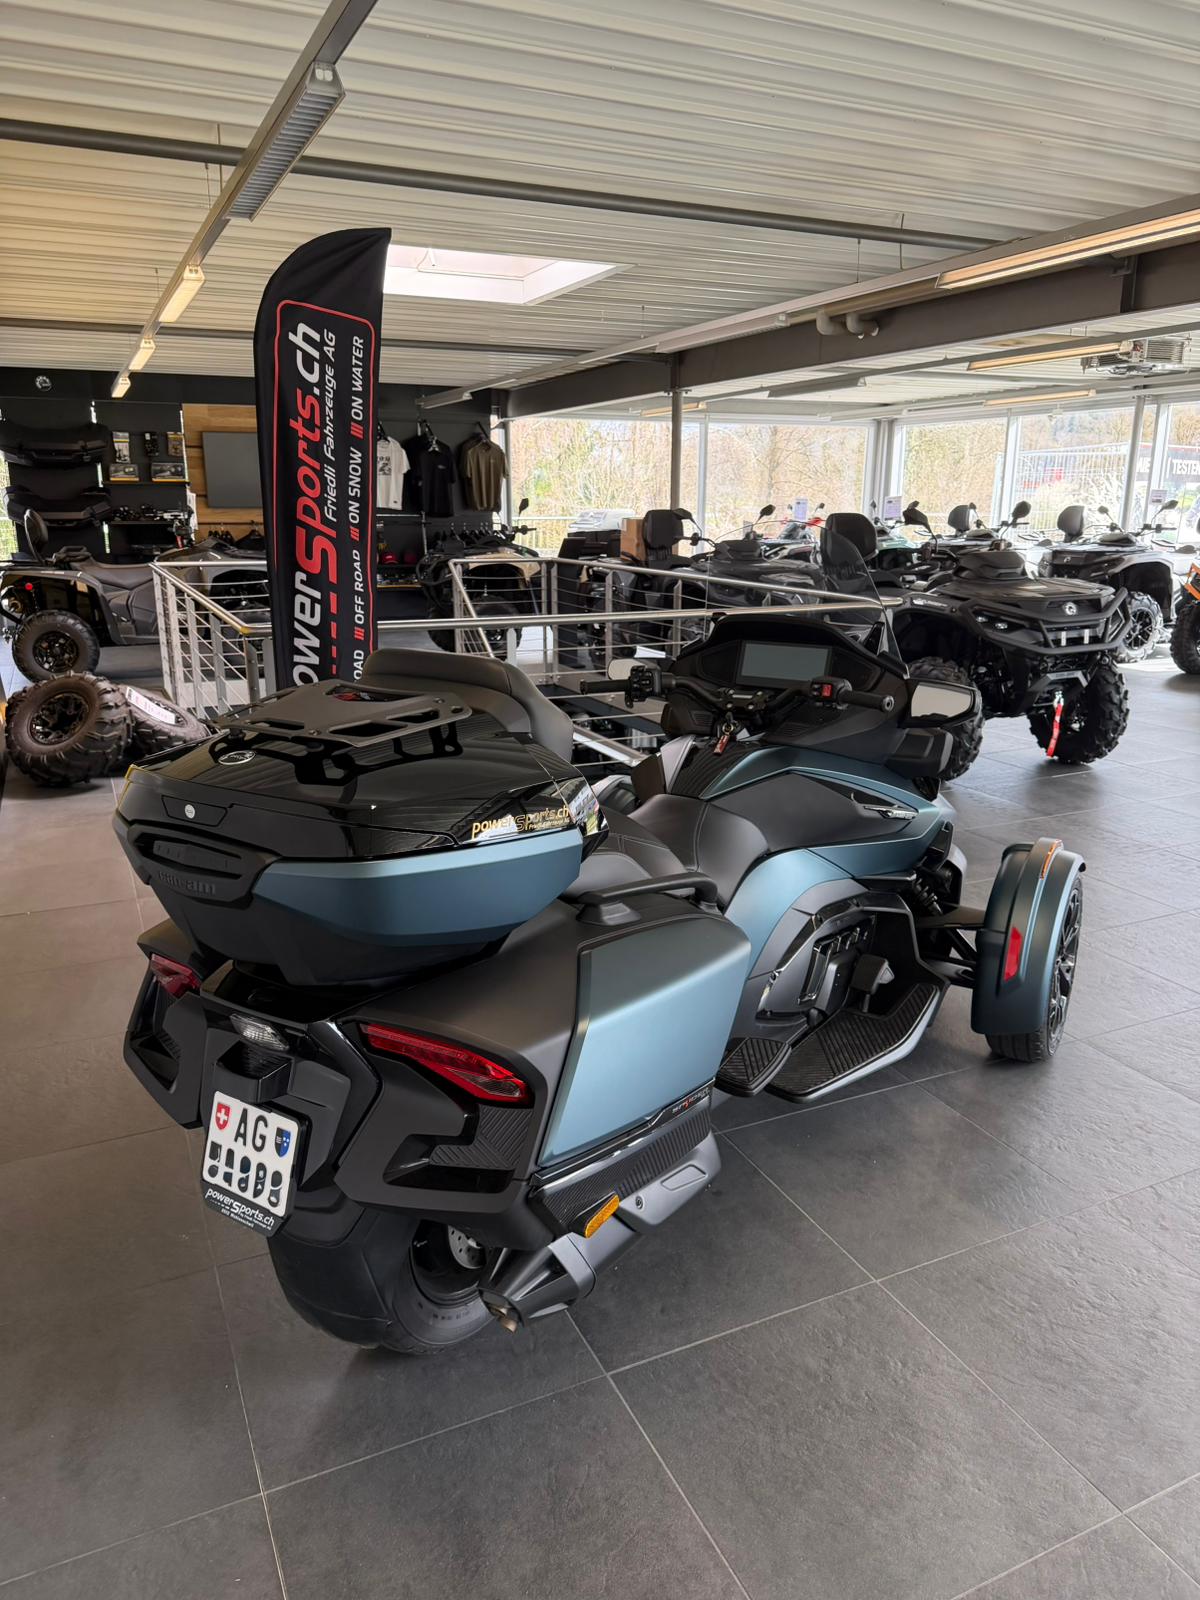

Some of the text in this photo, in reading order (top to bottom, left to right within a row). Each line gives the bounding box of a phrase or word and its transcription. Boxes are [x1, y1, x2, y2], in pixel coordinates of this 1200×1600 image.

[323, 328, 337, 522] Friedli Fahrzeuge AG
[288, 322, 337, 687] owerSports.ch
[348, 335, 365, 682] OAD OFF ROAD ON SNOW ON WATER
[471, 805, 570, 840] powerSports.ch
[234, 1107, 268, 1152] AG
[205, 1188, 275, 1227] powerSports.ch
